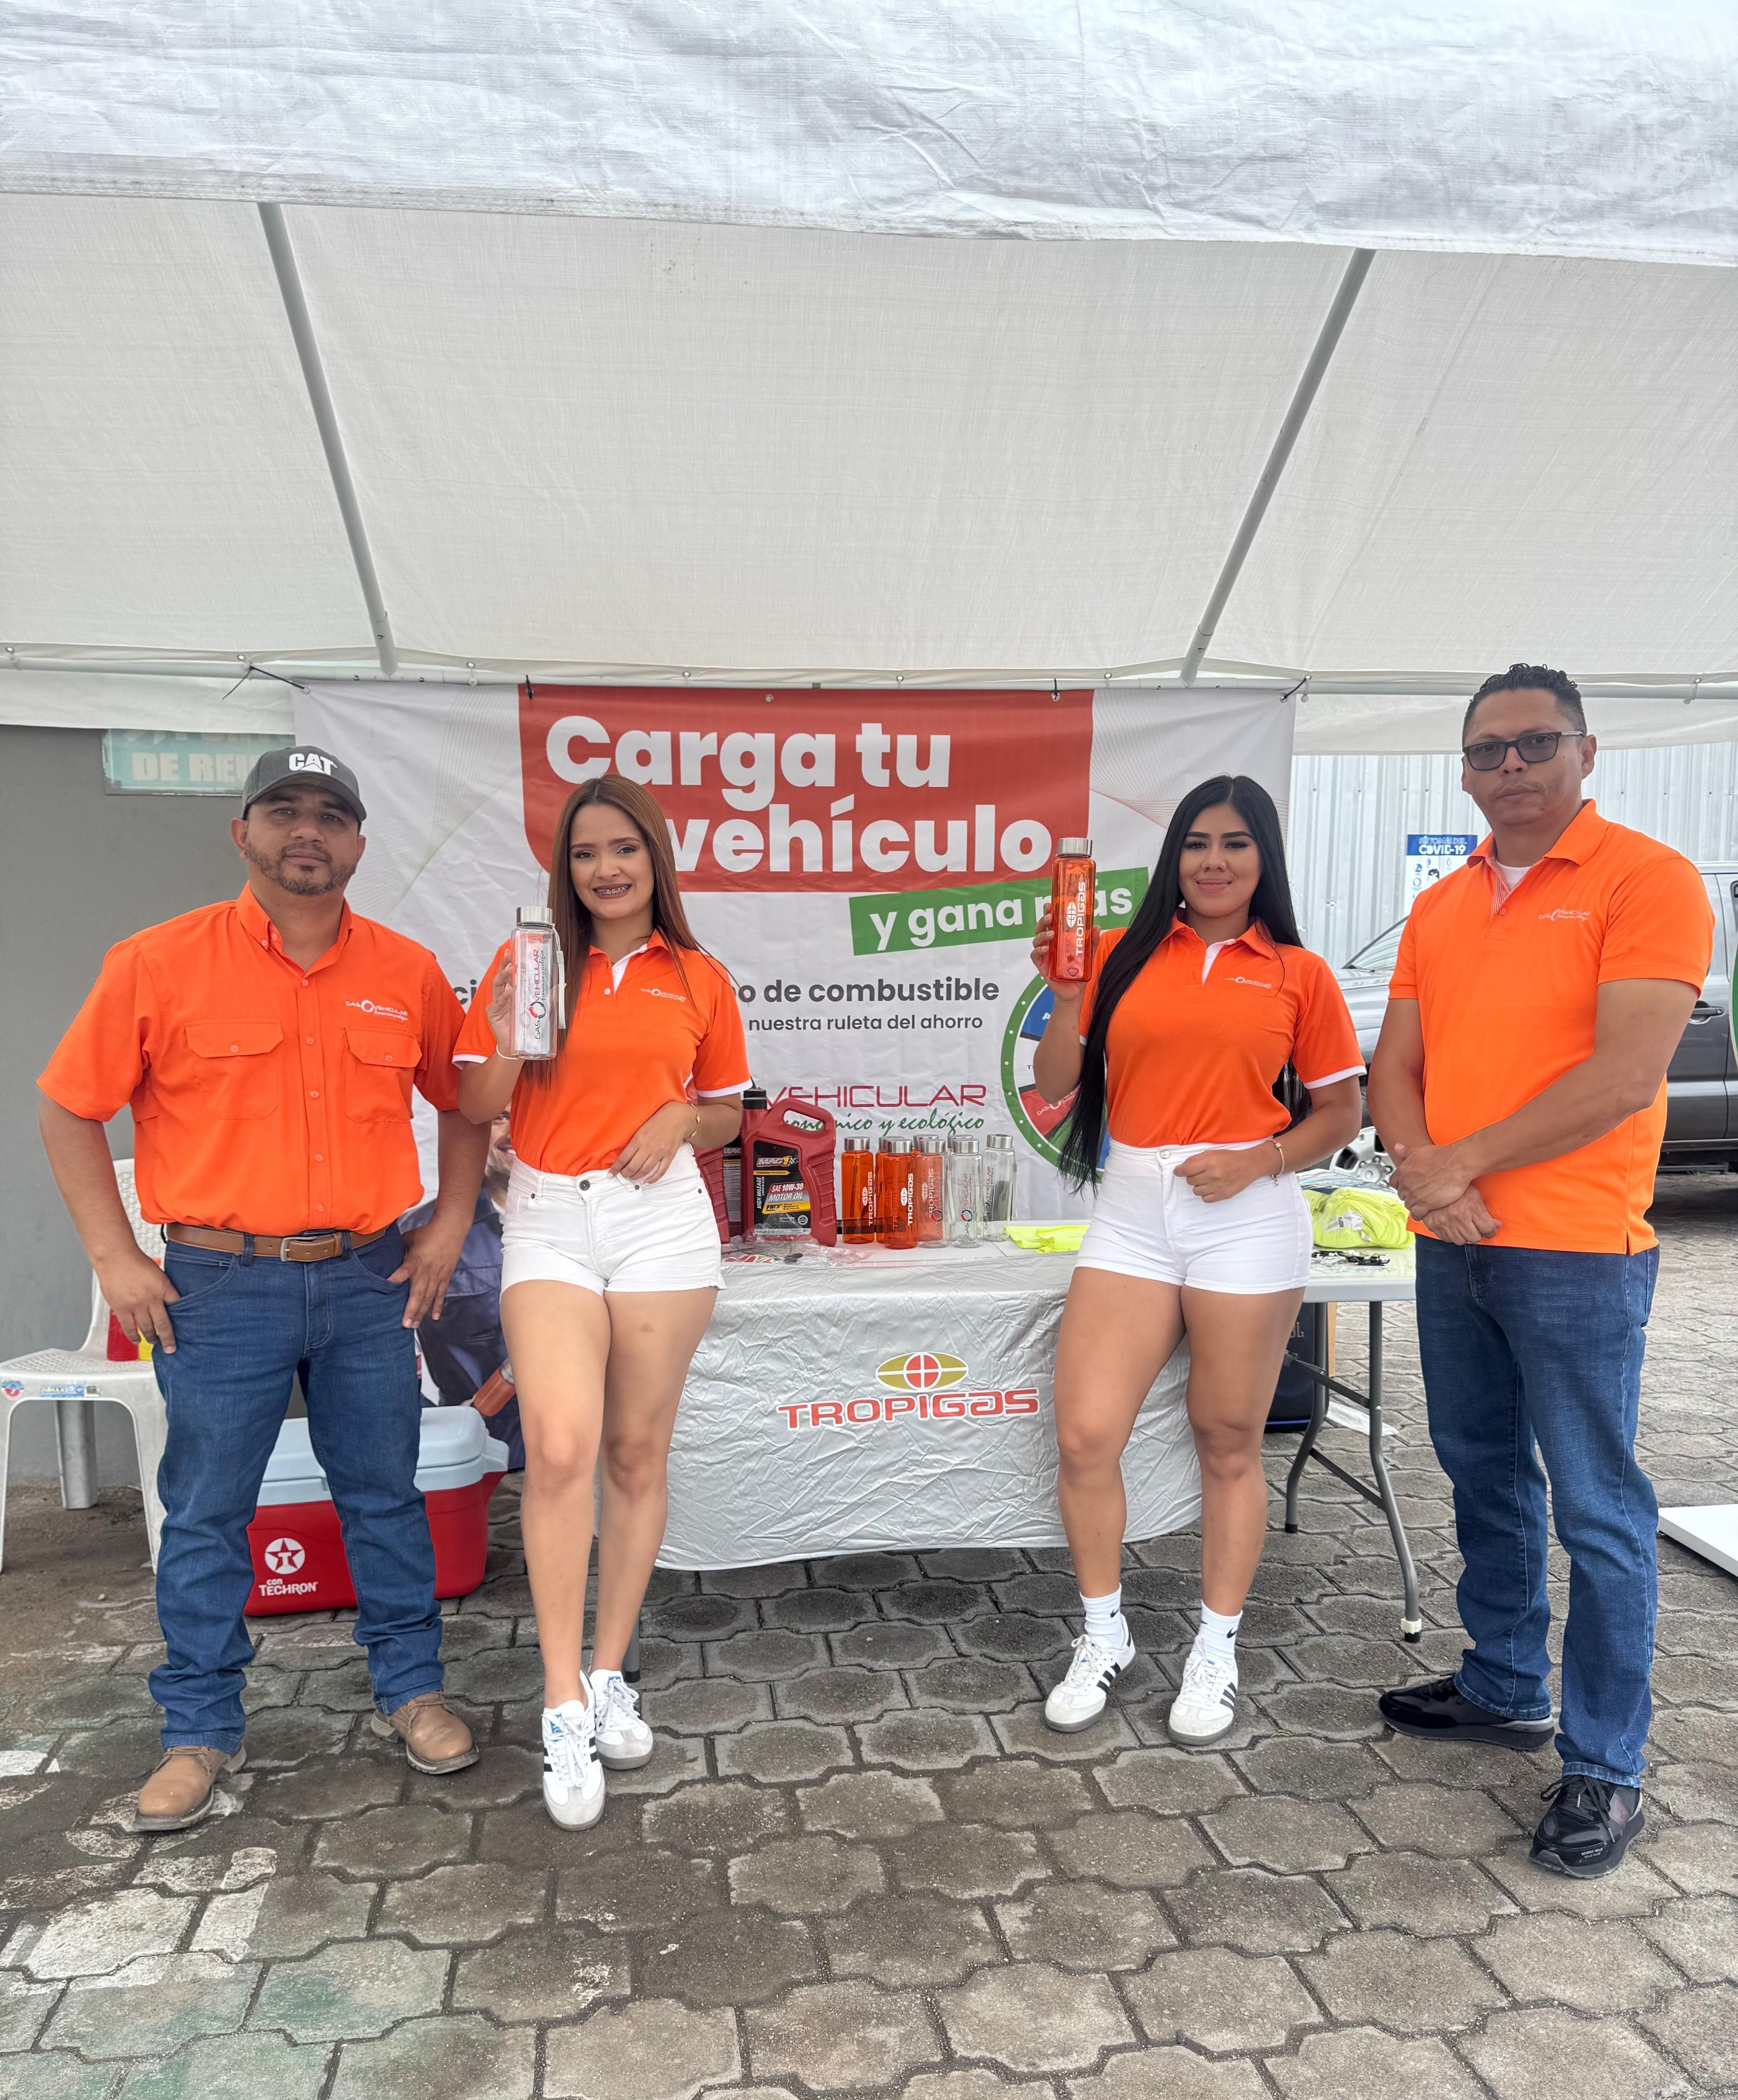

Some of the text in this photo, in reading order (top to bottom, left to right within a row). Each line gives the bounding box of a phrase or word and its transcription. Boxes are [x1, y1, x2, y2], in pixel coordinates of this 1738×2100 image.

[132, 752, 259, 782] DE REU
[289, 753, 336, 775] CAT
[546, 715, 951, 811] Carga tu
[665, 794, 1052, 873] vehículo
[1418, 844, 1466, 855] COVID-19
[869, 912, 898, 951] y
[908, 899, 1023, 947] gana
[764, 979, 801, 1002] de
[809, 976, 999, 1002] combustible
[749, 1015, 983, 1030] nuestra ruleta del ahorro
[766, 1085, 986, 1108] VEHICULAR
[878, 1119, 895, 1136] y
[898, 1108, 984, 1136] ecológico
[768, 1193, 793, 1201] MOTOR
[782, 1183, 804, 1191] 10W-30
[258, 1582, 317, 1596] TECHRON
